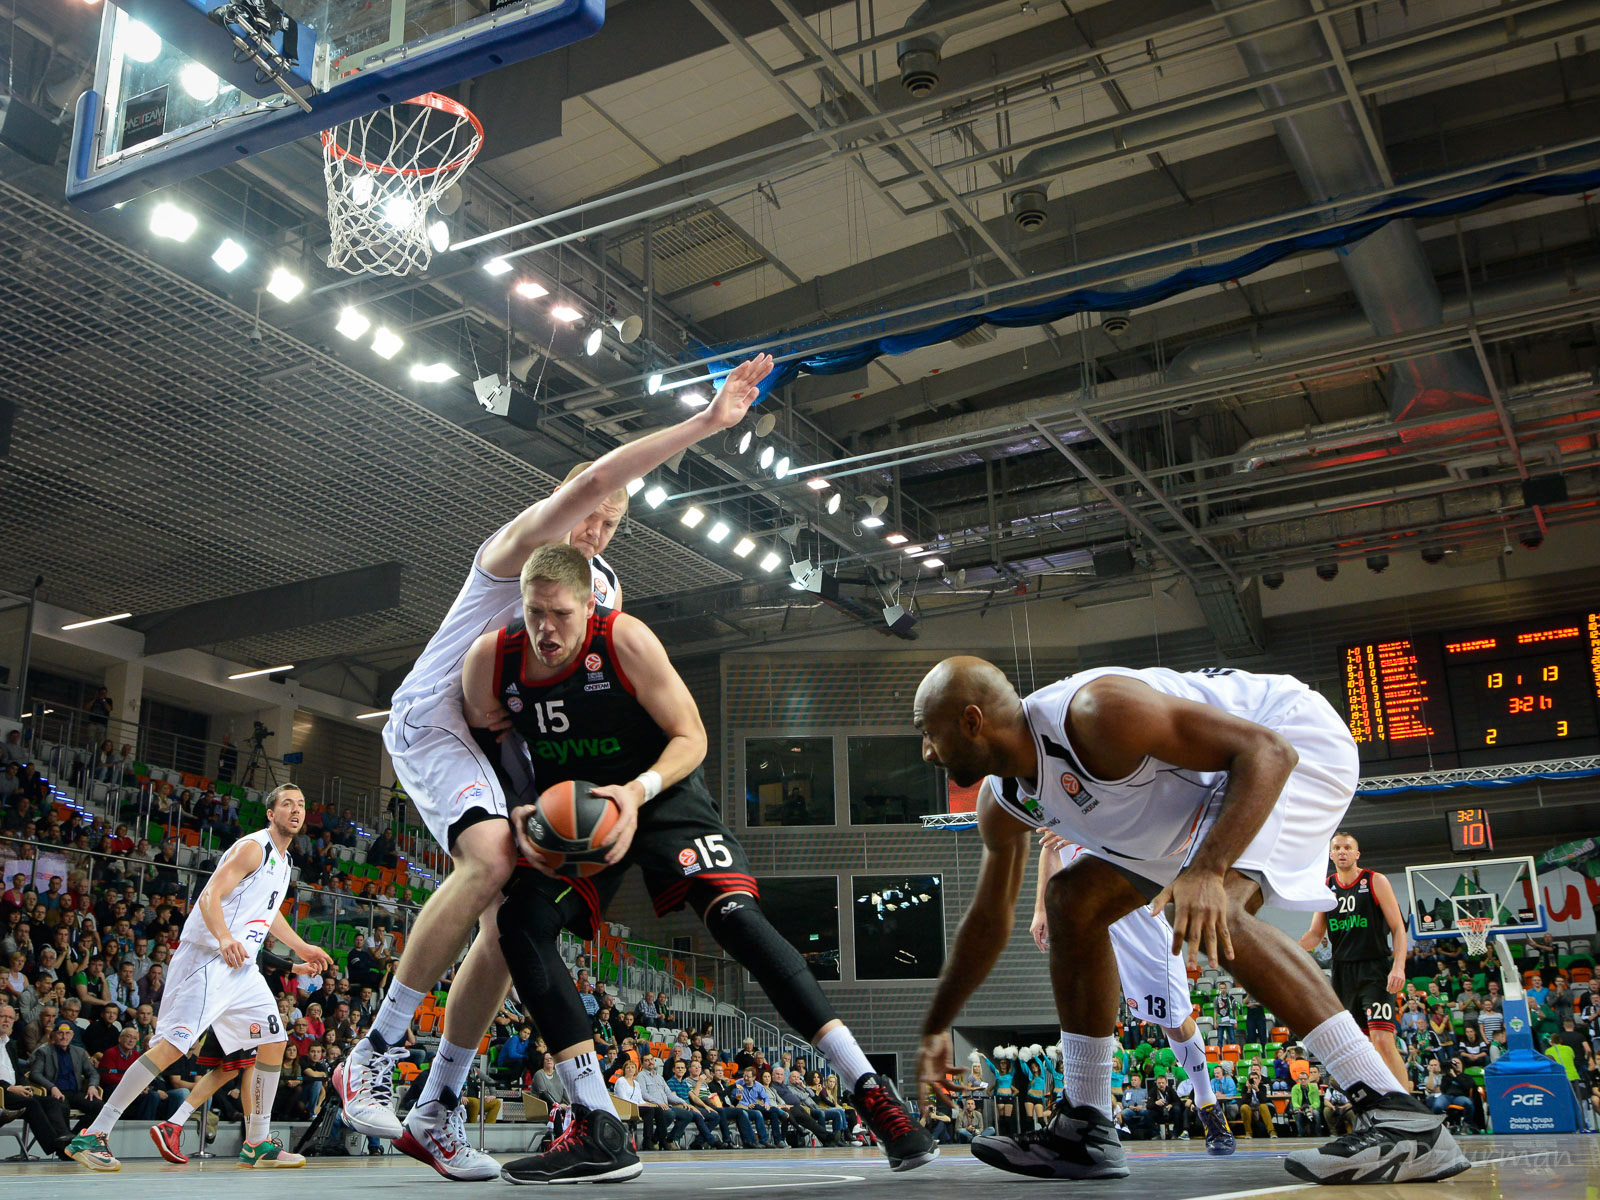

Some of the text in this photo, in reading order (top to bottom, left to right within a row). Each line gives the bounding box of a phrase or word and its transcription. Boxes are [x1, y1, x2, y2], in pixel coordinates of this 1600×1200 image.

[1487, 665, 1559, 688] 13 1 13
[534, 700, 570, 733] 15
[1486, 720, 1568, 744] 2 3
[1457, 809, 1482, 823] 3:21
[1463, 823, 1484, 846] 10
[694, 834, 733, 869] 15
[267, 890, 278, 910] 8
[1338, 895, 1356, 913] 20
[1329, 914, 1368, 932] BayWa
[1144, 994, 1166, 1019] 13
[1373, 1002, 1392, 1020] 20
[267, 1014, 279, 1034] 8
[173, 1030, 191, 1040] PGE
[1511, 1093, 1544, 1107] PGE
[1532, 1116, 1553, 1124] Grupa
